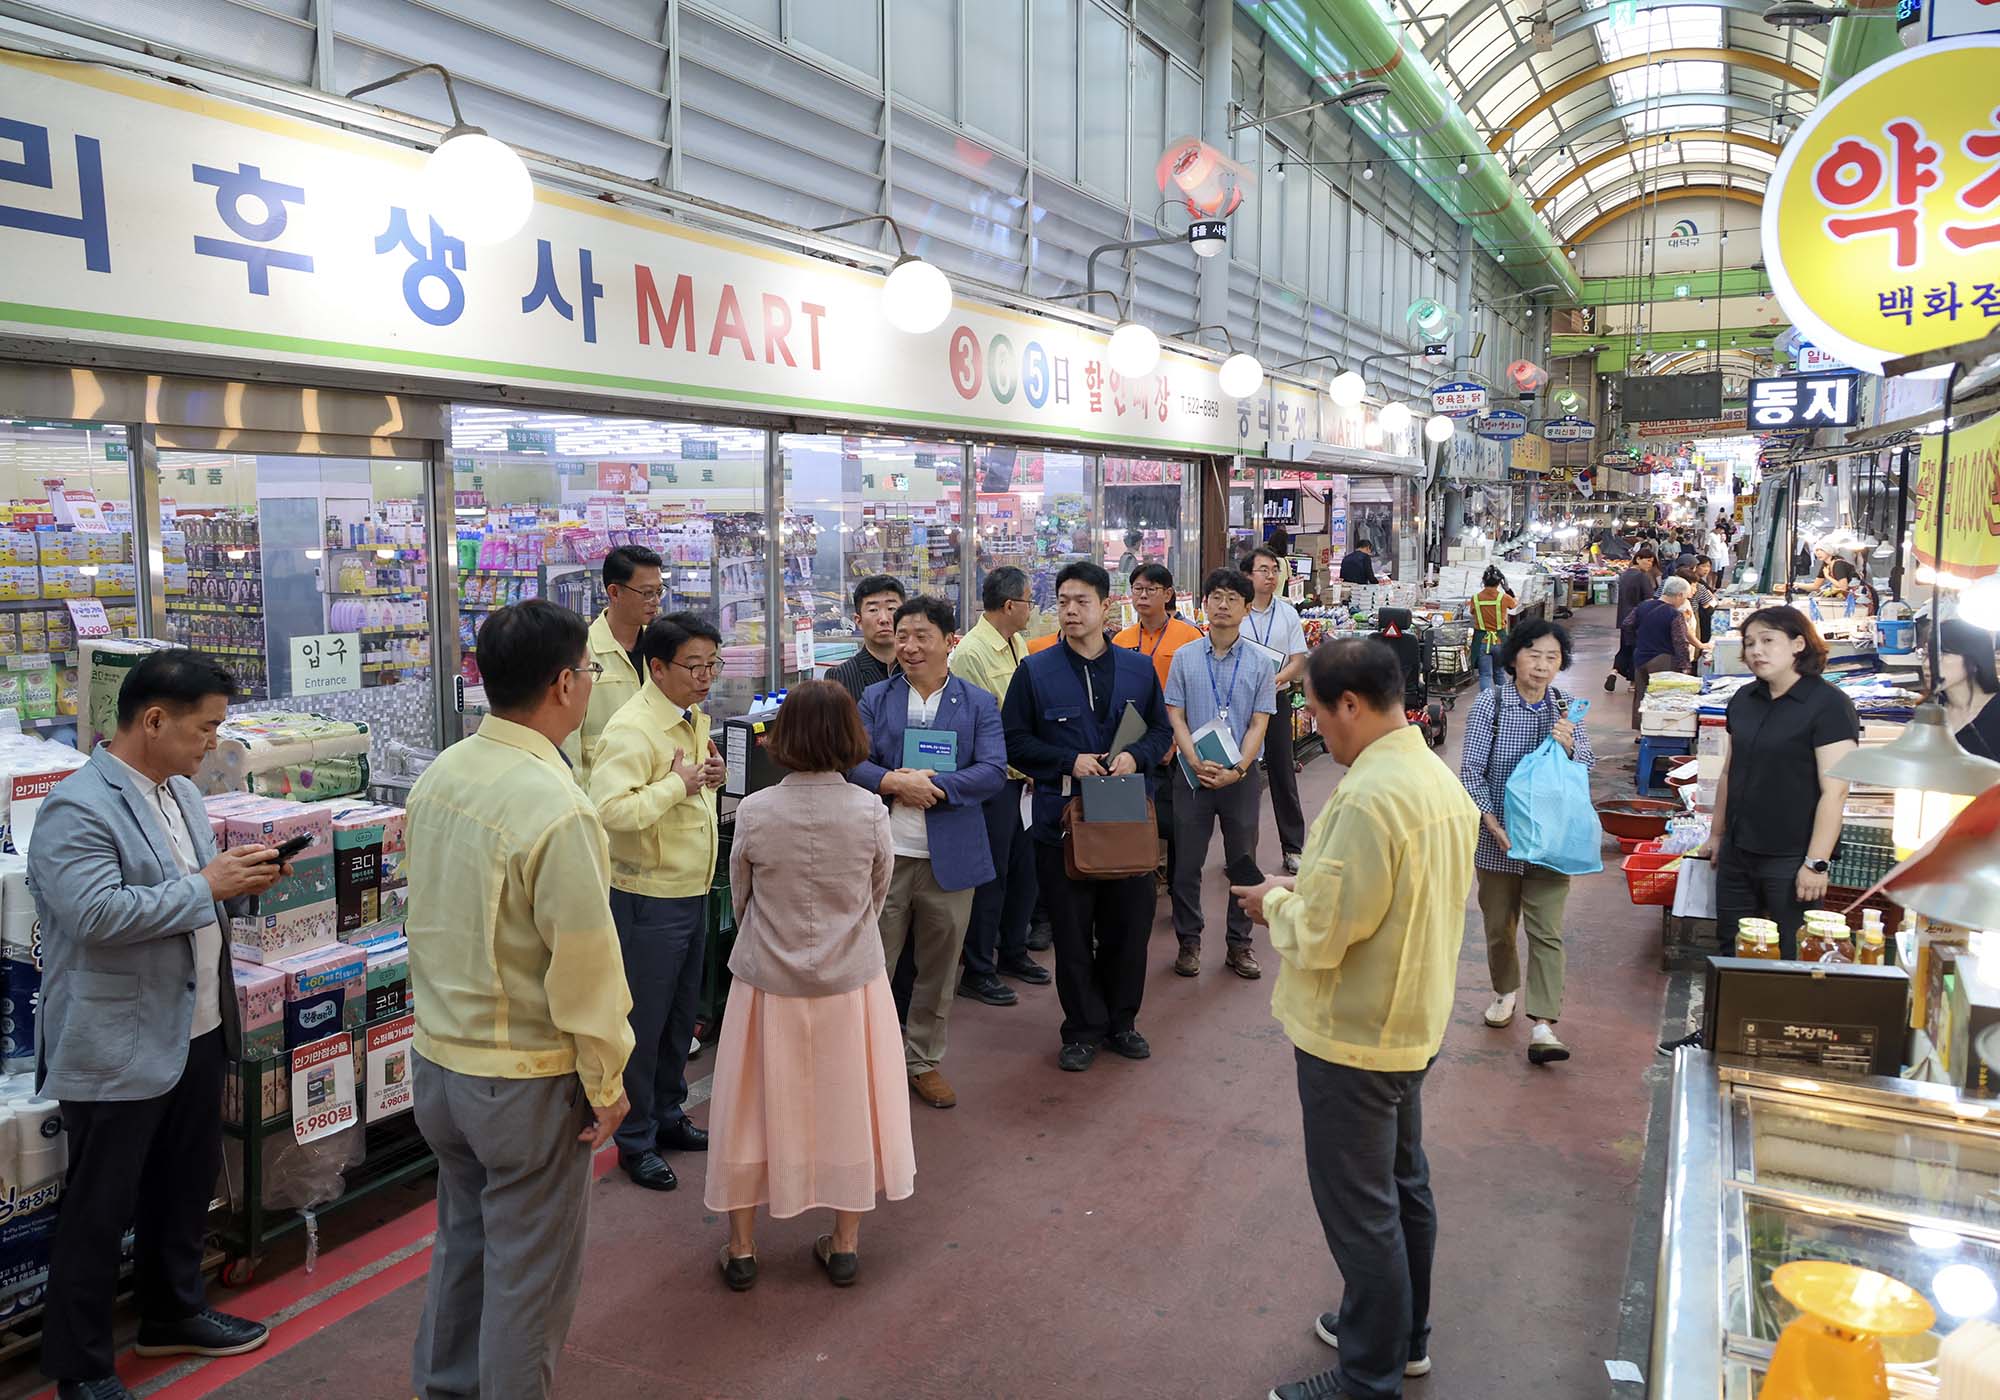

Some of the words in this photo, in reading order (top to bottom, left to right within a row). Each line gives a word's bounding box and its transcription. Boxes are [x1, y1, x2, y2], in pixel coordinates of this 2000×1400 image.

[1668, 237, 1700, 247] 대덕구
[635, 264, 826, 370] MART
[1753, 379, 1849, 424] 동지
[302, 638, 348, 669] 입구
[304, 676, 347, 688] Entrance
[352, 853, 375, 872] 코디
[376, 991, 399, 1011] 코디
[294, 1041, 348, 1068] 인기만점상품
[380, 1092, 410, 1110] 4,980원
[296, 1105, 353, 1137] 5,980원
[18, 1184, 58, 1211] 화장지
